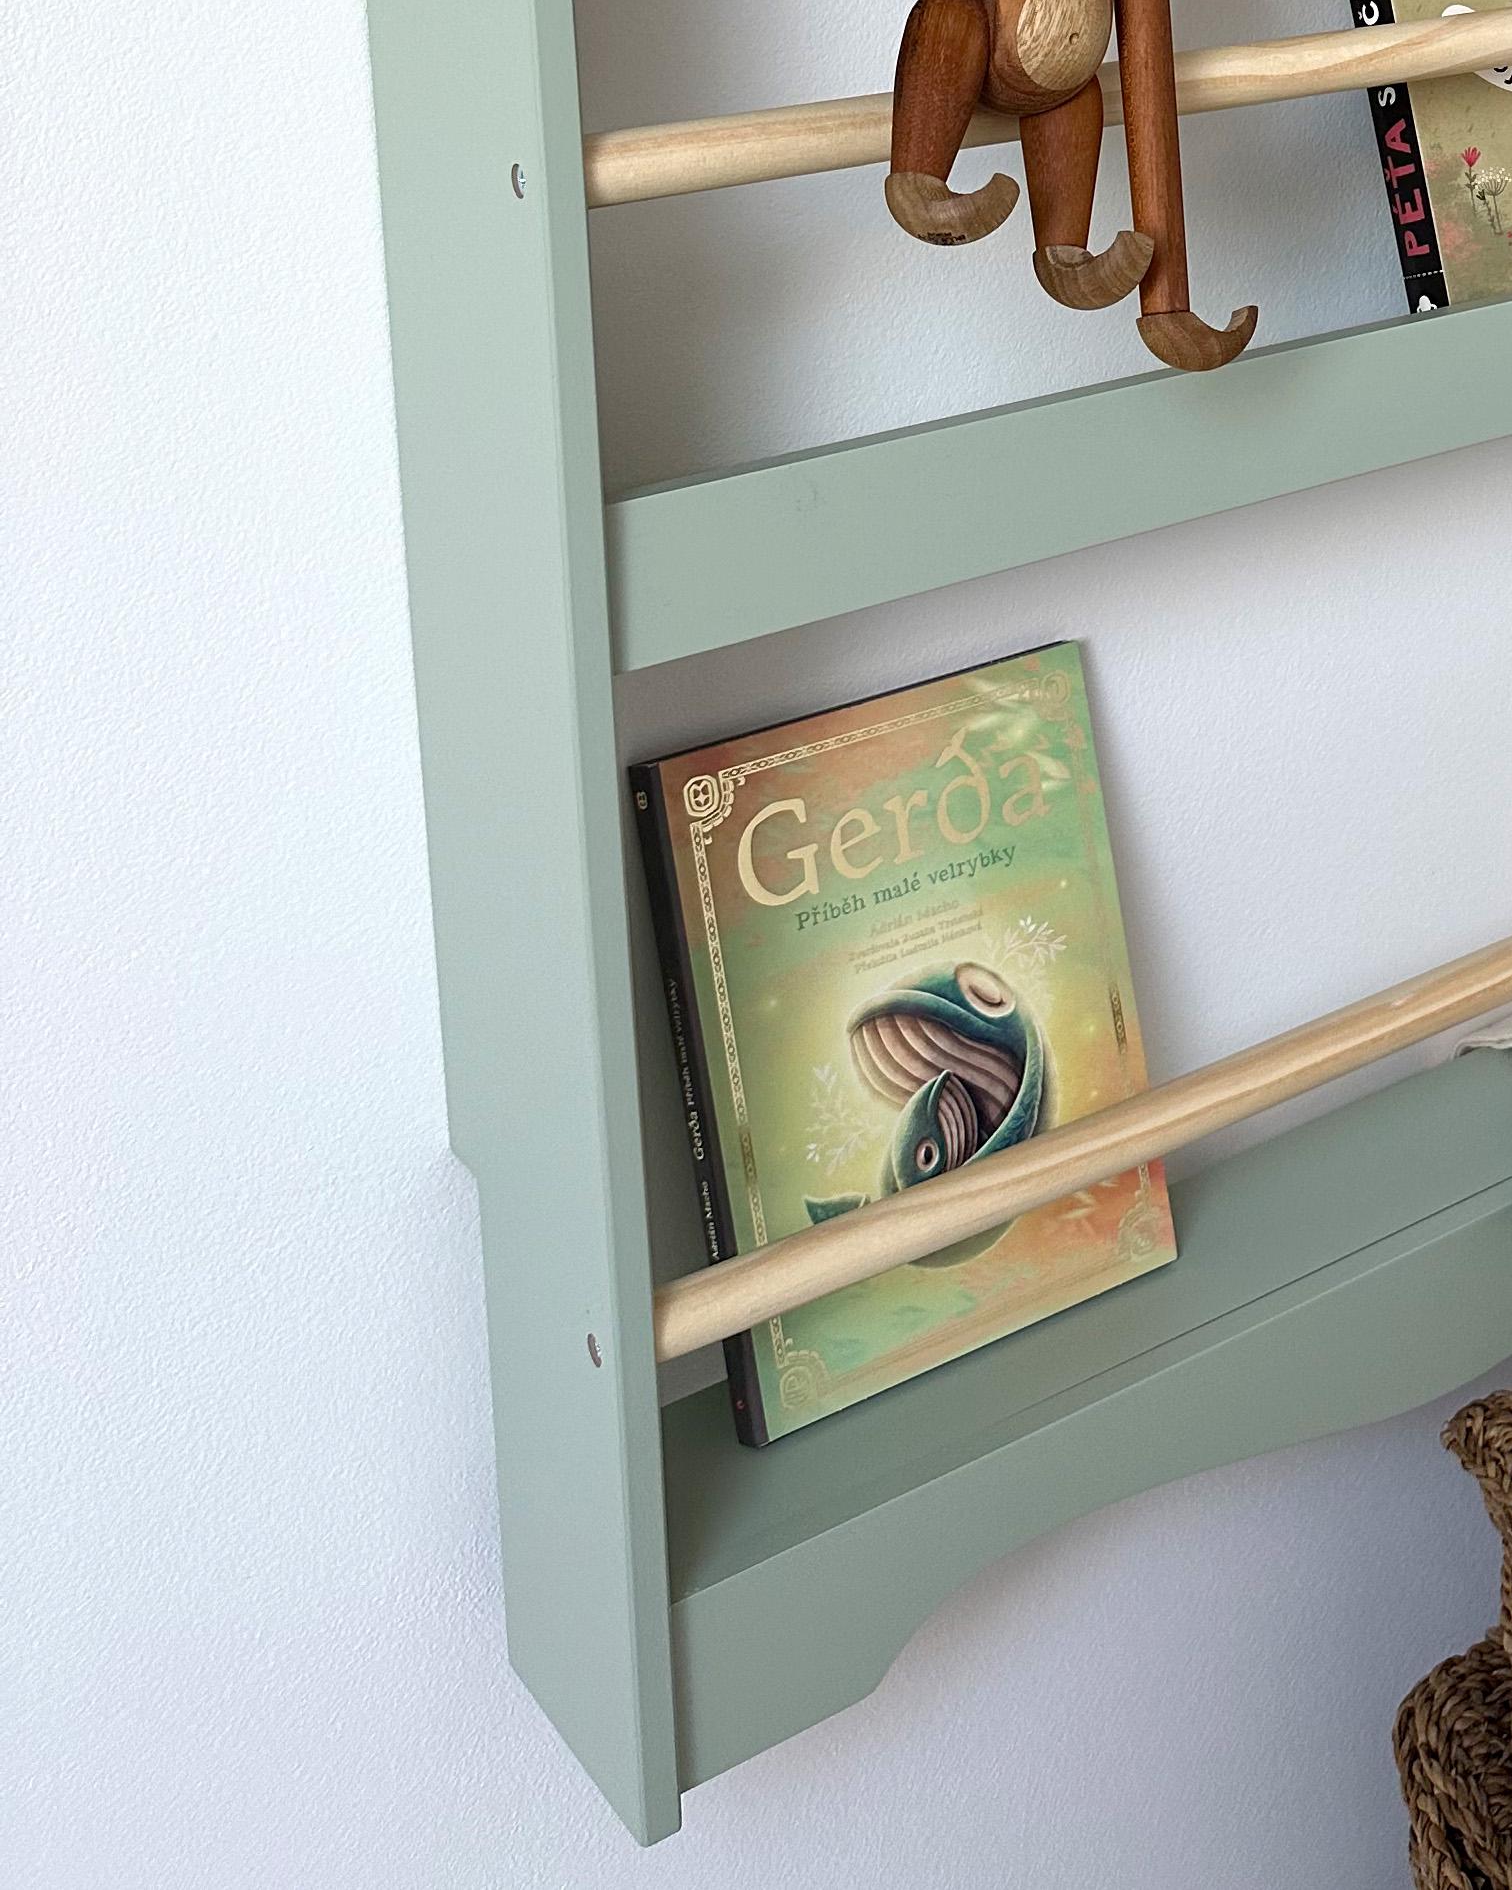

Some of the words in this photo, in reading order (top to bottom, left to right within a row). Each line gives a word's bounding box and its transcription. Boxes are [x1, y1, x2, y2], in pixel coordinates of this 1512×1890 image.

[1378, 86, 1396, 107] S
[1384, 118, 1430, 257] PÉŤA
[737, 726, 1051, 906] Gerda
[796, 894, 866, 931] Příběh
[873, 871, 922, 905] malé
[927, 845, 1017, 885] velrybky
[688, 1111, 705, 1161] Gerda
